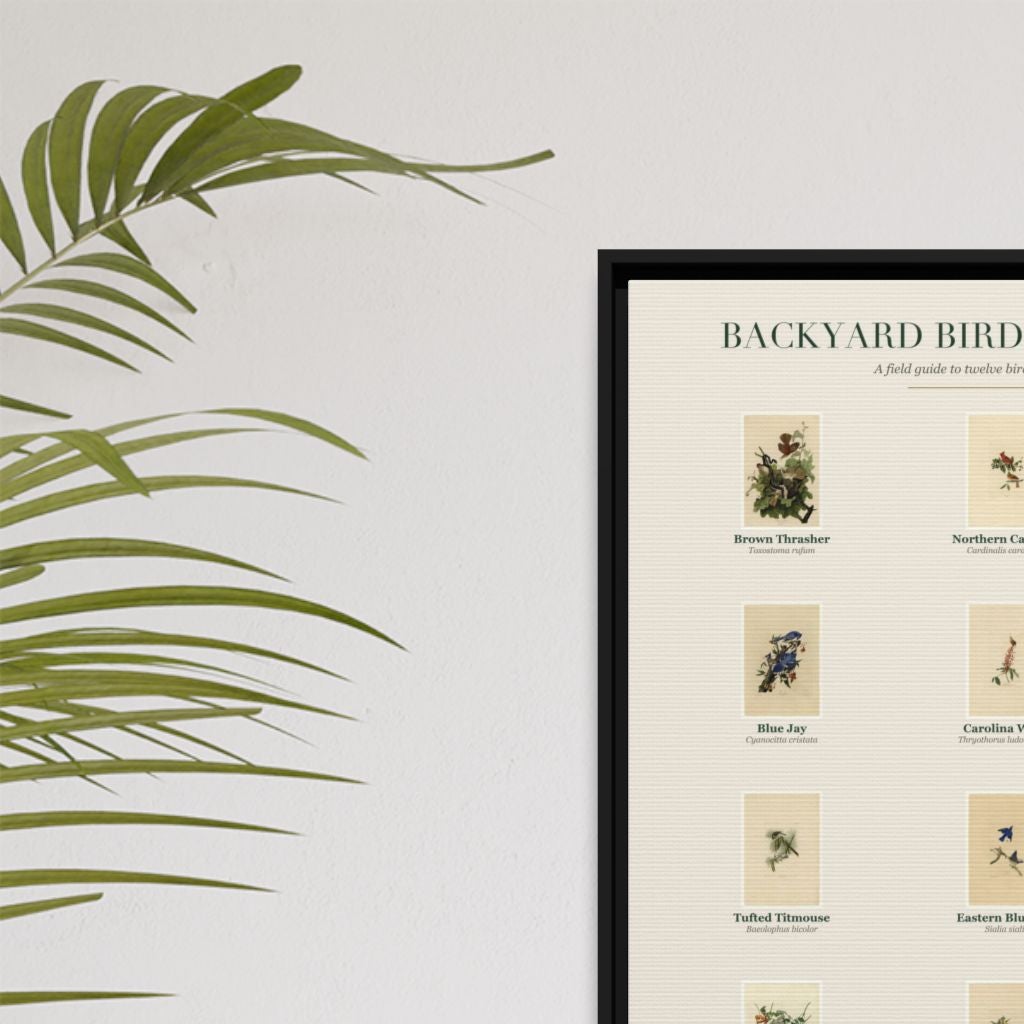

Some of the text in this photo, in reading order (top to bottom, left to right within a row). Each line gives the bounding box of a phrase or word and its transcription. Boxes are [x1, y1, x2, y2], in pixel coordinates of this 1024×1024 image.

[721, 322, 922, 348] BACKYARD
[873, 364, 882, 374] A
[884, 363, 912, 376] field
[914, 363, 947, 376] guide
[950, 364, 961, 374] to
[964, 363, 1002, 374] twelve
[734, 534, 830, 544] Brown Thrasher
[952, 534, 1007, 544] Northern
[757, 723, 807, 736] Blue Jay
[963, 723, 1014, 733] Carolina
[733, 912, 830, 922] Tufted Titmouse
[957, 912, 1002, 922] Eastern
